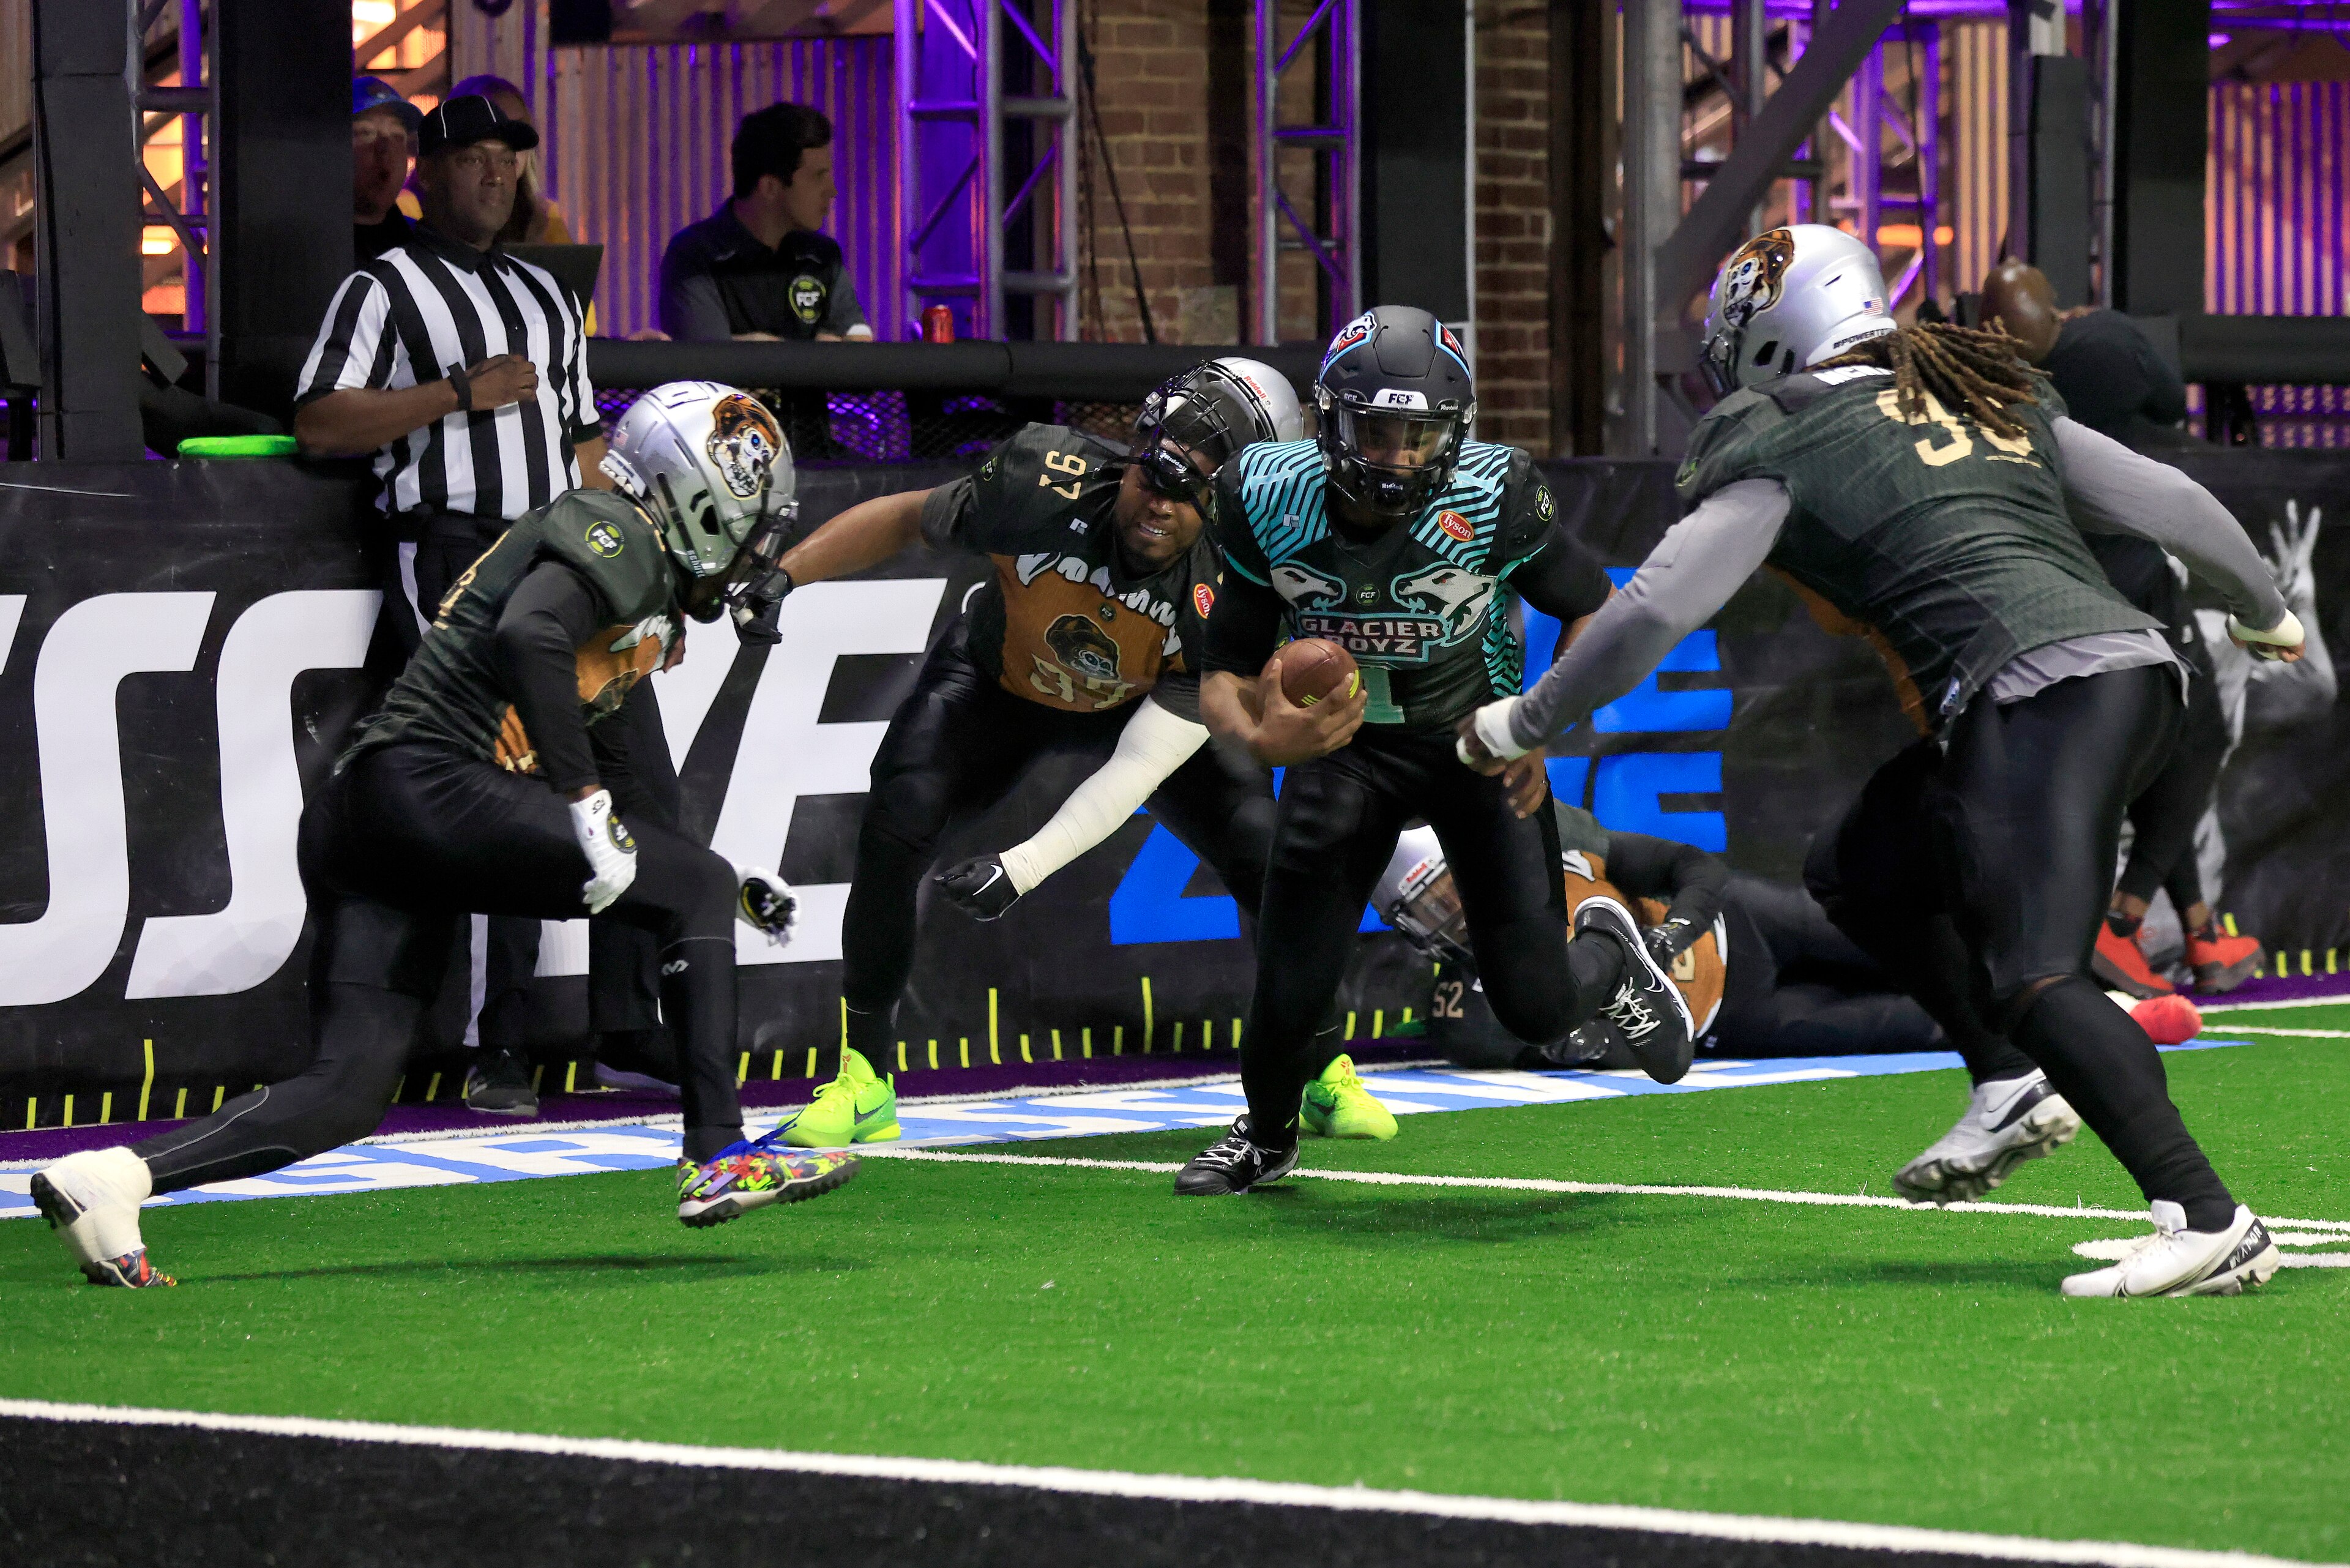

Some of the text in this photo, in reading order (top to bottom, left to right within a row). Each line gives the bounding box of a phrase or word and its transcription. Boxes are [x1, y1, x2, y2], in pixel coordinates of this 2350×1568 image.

[1244, 375, 1267, 399] Riddell
[1388, 393, 1414, 405] FCF
[1039, 450, 1087, 500] 97
[1540, 491, 1550, 515] FCF
[1443, 512, 1472, 539] Tyson
[592, 529, 617, 548] FCF
[1302, 618, 1440, 637] GLACIER
[0, 578, 948, 1006] SSE
[1432, 981, 1463, 1018] 52
